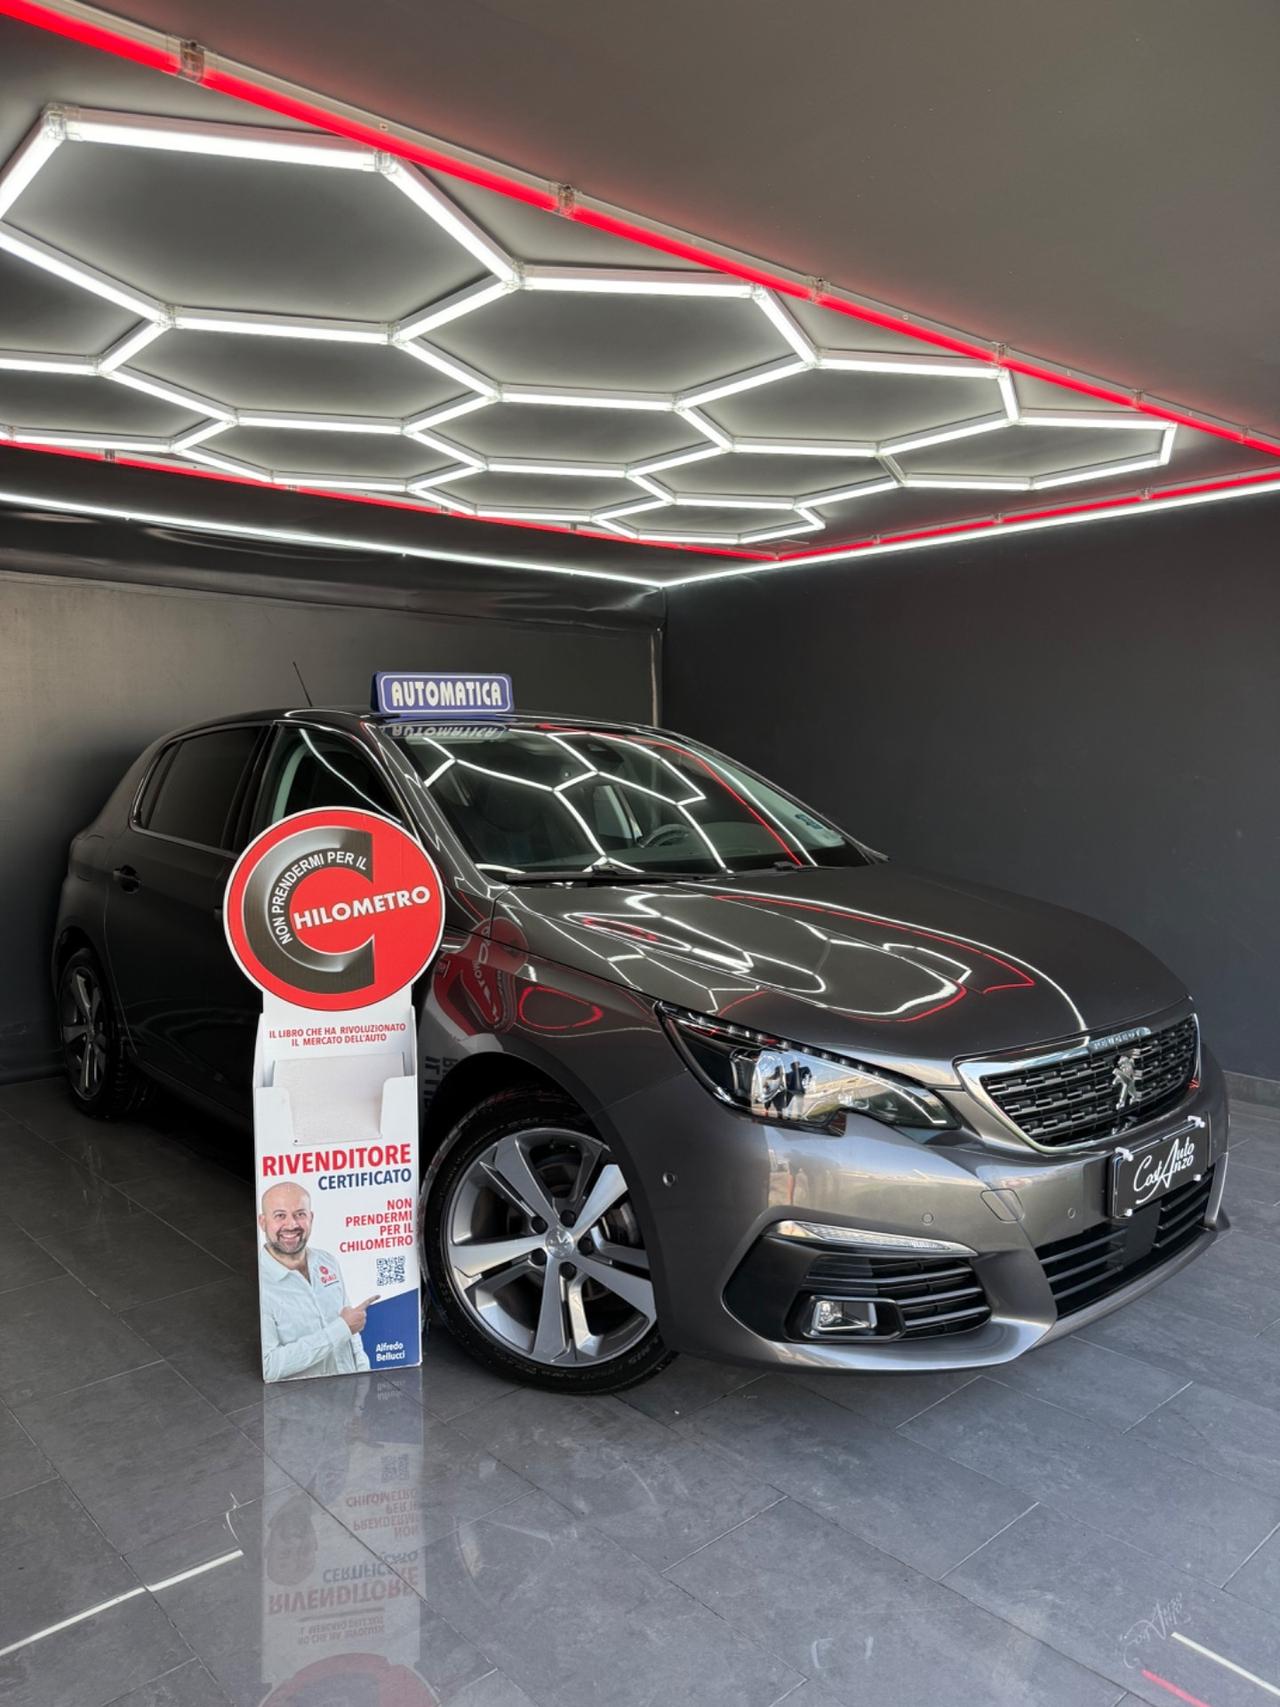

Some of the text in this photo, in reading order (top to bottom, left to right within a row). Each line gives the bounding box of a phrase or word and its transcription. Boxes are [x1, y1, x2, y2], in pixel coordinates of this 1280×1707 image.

[391, 681, 502, 707] AUTOMATICA
[271, 851, 367, 945] NON PRENDERMI PER IL
[269, 1023, 406, 1039] IL LIBRO CHE HA RIVOLUZIONATO
[291, 1033, 387, 1047] IL MERCATO DELL'AUTO
[262, 1143, 411, 1177] RIVENDITORE
[318, 1168, 411, 1190] CERTIFICATO
[387, 1198, 412, 1210] NON
[345, 1210, 412, 1227] PRENDERMI
[380, 1223, 413, 1236] PER IL
[339, 1235, 413, 1253] CHILOMETRO
[376, 1341, 404, 1352] Alfredo
[376, 1350, 406, 1362] Bellucci
